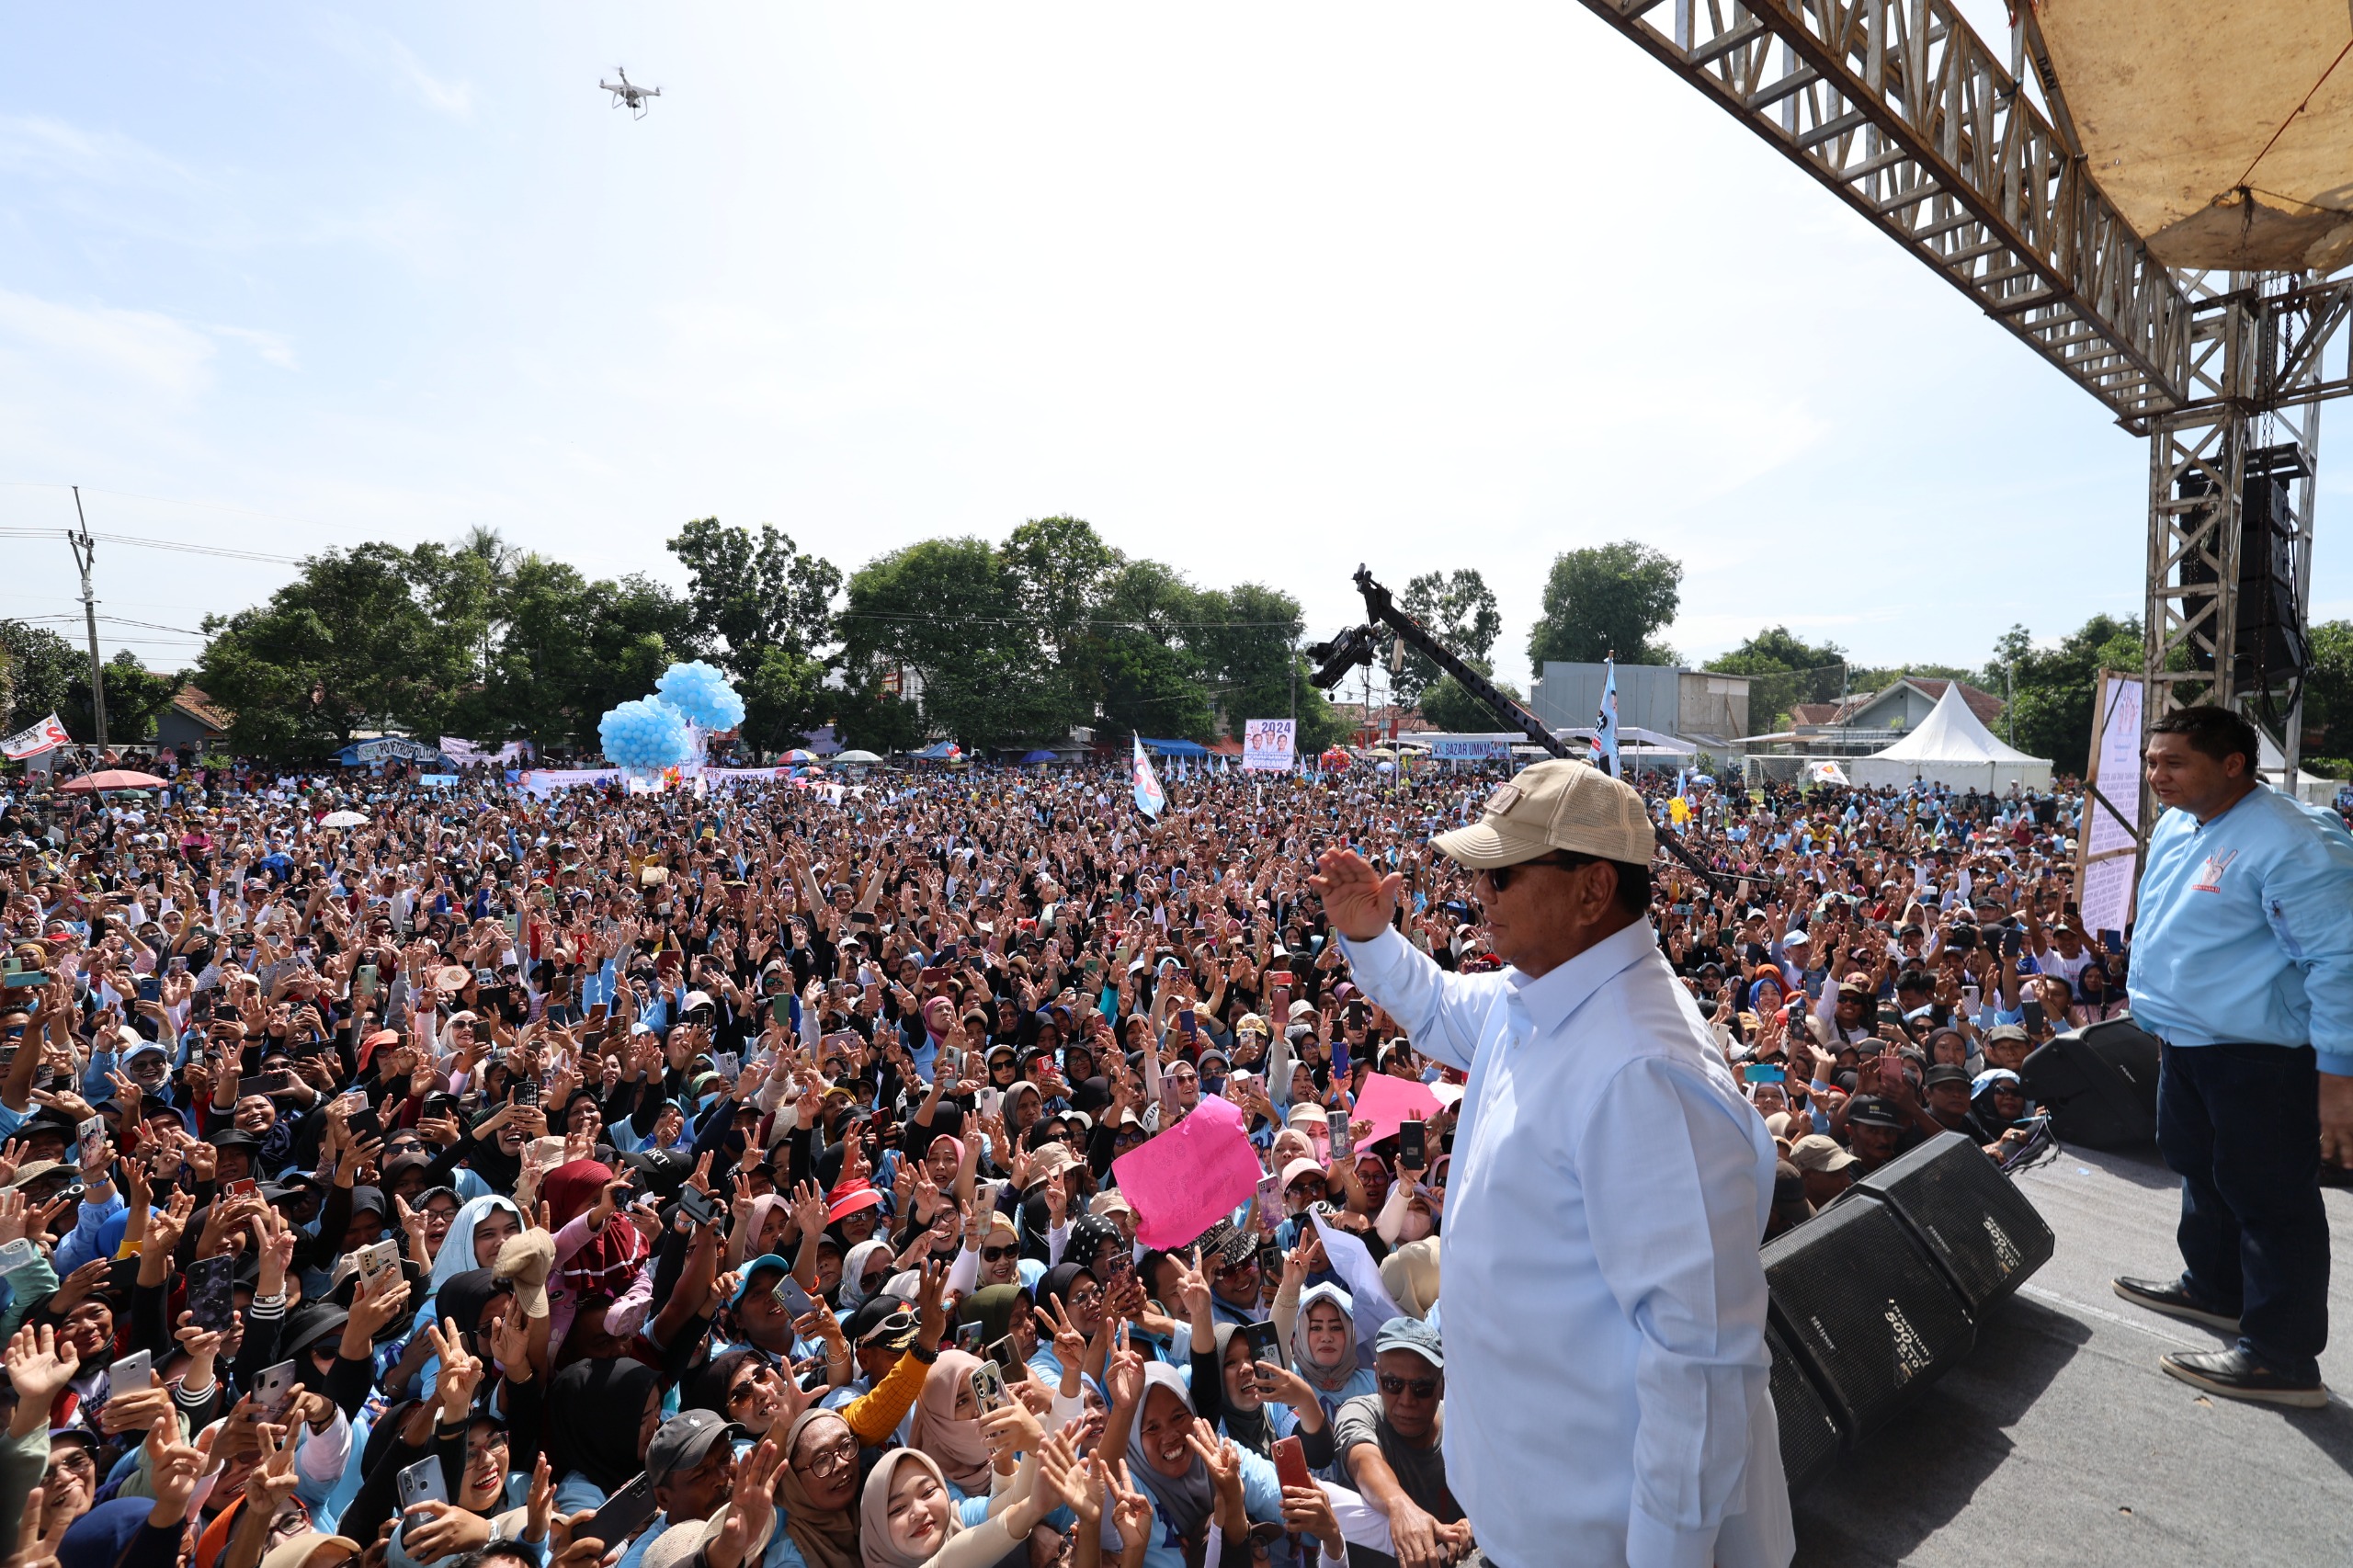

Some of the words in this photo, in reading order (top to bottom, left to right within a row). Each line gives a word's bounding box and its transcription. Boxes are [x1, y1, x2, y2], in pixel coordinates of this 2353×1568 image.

[1261, 722, 1291, 733] 2024
[1247, 751, 1290, 760] PRABOWO
[1446, 744, 1468, 756] BAZAR
[1469, 743, 1491, 756] UMKM
[1253, 760, 1283, 768] GIBRAN
[1984, 1221, 2006, 1246] 500
[1885, 1312, 1913, 1344] 500
[1893, 1305, 1930, 1357] Premium
[1894, 1335, 1919, 1368] JS10
